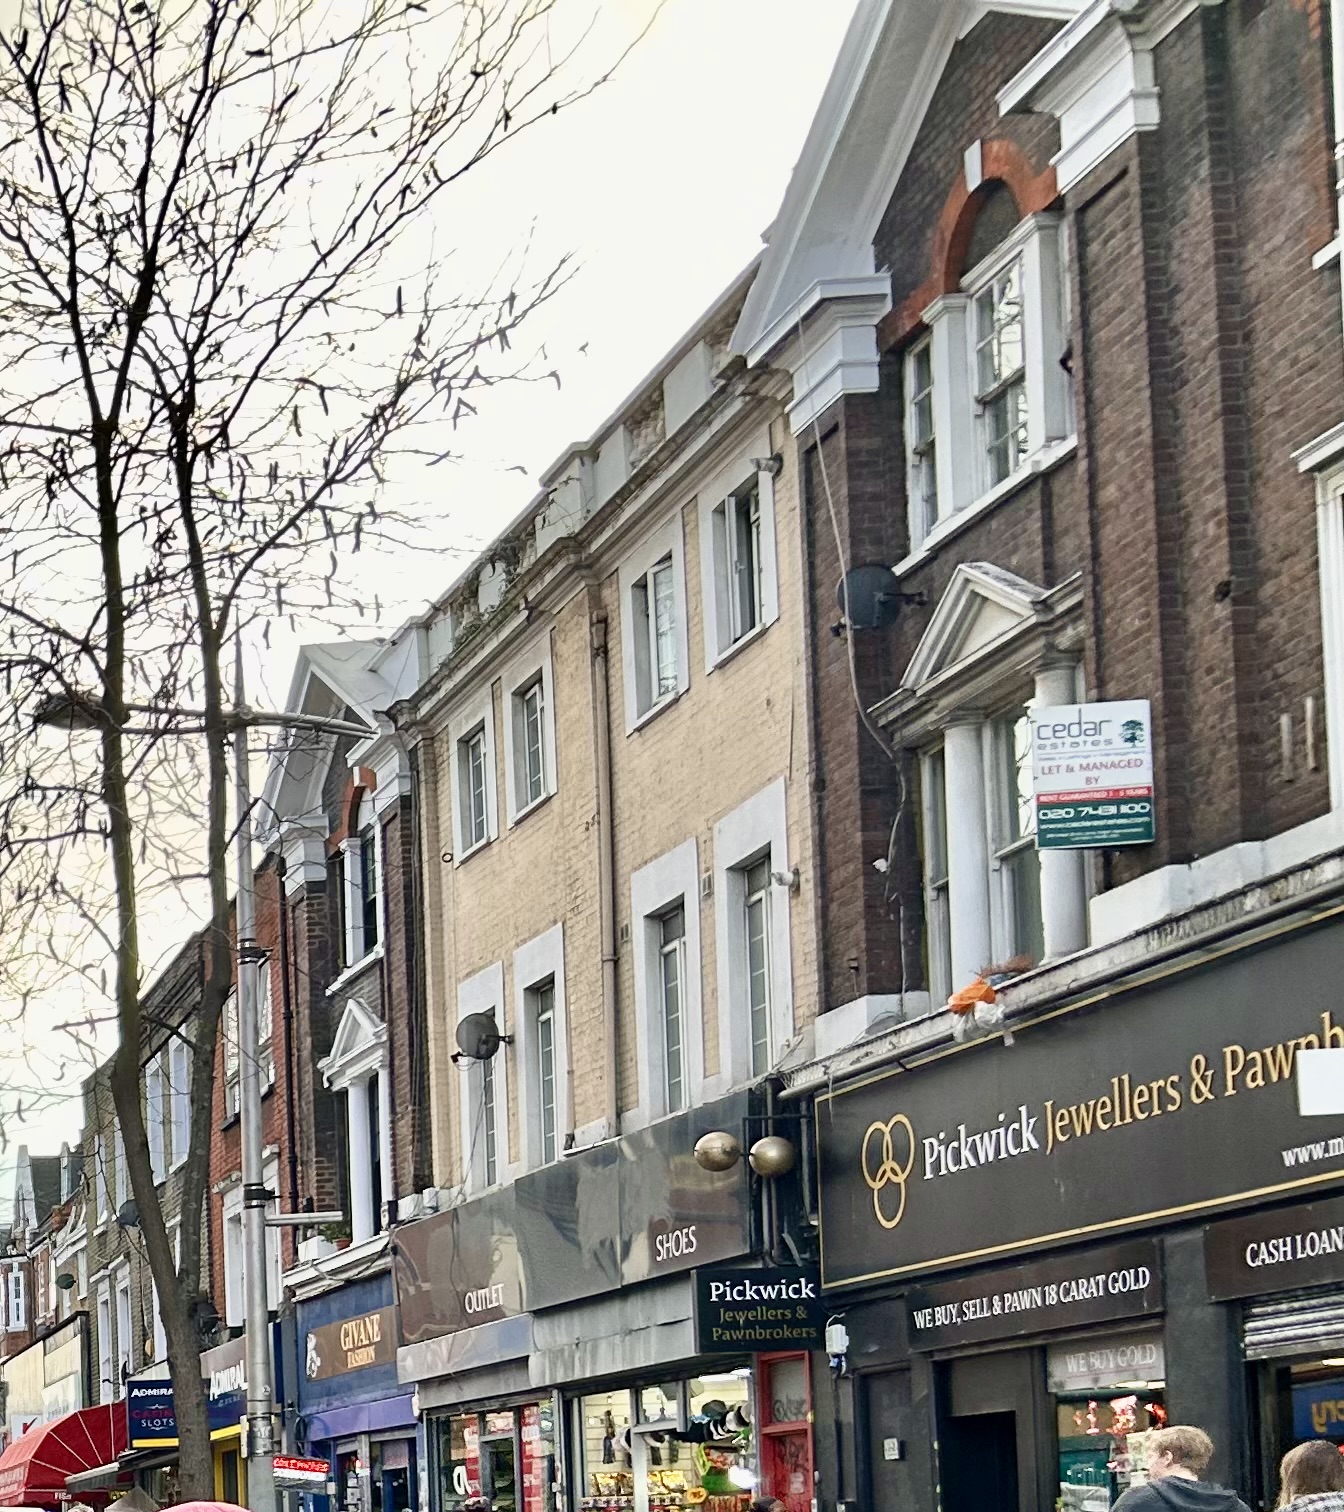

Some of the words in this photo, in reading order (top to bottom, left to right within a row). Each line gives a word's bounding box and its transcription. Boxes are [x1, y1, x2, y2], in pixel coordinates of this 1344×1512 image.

[1037, 708, 1112, 740] cedar
[1037, 738, 1113, 750] estates
[1041, 764, 1061, 775] LET
[1079, 758, 1143, 772] MANAGED
[1085, 776, 1101, 786] BY
[1039, 808, 1074, 820] 020
[923, 1105, 1039, 1181] Pickwick
[1045, 1073, 1182, 1155] Jewellers
[1190, 1054, 1215, 1104] &
[656, 1226, 696, 1262] SHOES
[1246, 1234, 1292, 1268] CASH
[465, 1283, 504, 1314] OUTLET
[710, 1278, 815, 1302] Pickwick
[913, 1309, 934, 1330] WE
[935, 1304, 961, 1327] BUY,
[962, 1297, 990, 1322] SELL
[992, 1296, 1003, 1316] &
[1004, 1287, 1042, 1315] PAWN
[1044, 1285, 1058, 1307] 18
[1058, 1274, 1107, 1304] CARAT
[1108, 1266, 1151, 1293] GOLD
[719, 1306, 792, 1325] Jewellers
[796, 1306, 808, 1319] &
[340, 1314, 380, 1350] GIVANE
[712, 1324, 817, 1342] Pawnbrokers
[1066, 1353, 1087, 1374] WE
[1088, 1350, 1113, 1371] BUY
[1117, 1343, 1157, 1368] GOLD
[131, 1388, 174, 1398] ADMIRA
[210, 1360, 248, 1400] ADMIRAL
[141, 1419, 174, 1427] SLOTS
